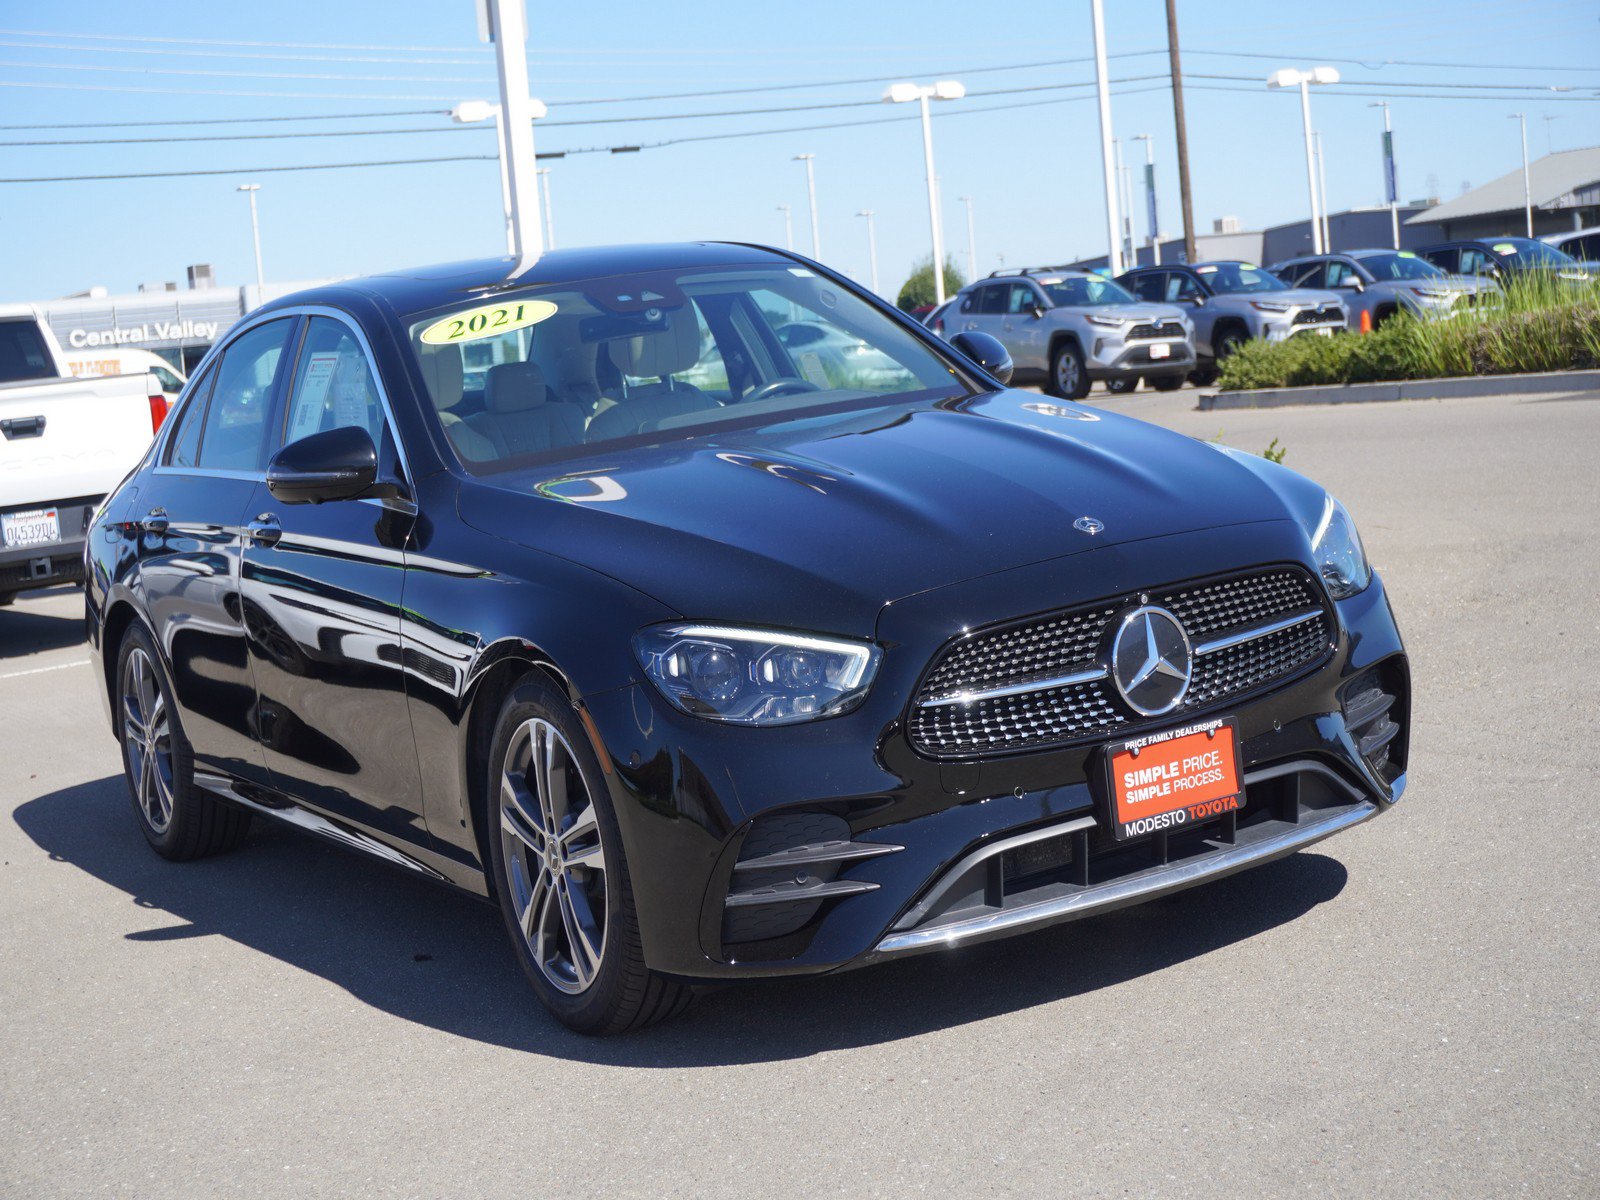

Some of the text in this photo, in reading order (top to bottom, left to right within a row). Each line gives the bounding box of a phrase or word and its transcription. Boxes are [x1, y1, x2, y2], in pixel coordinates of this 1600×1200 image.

[69, 320, 218, 348] Central Valley
[448, 304, 525, 340] 2021
[1125, 719, 1223, 750] PRICE FAMILY DEALERSHIPS
[1124, 750, 1223, 788] SIMPLE PRICE.
[1126, 768, 1225, 804] SIMPLE PROCESS.
[1125, 796, 1239, 837] MODESTO TOYOTA
